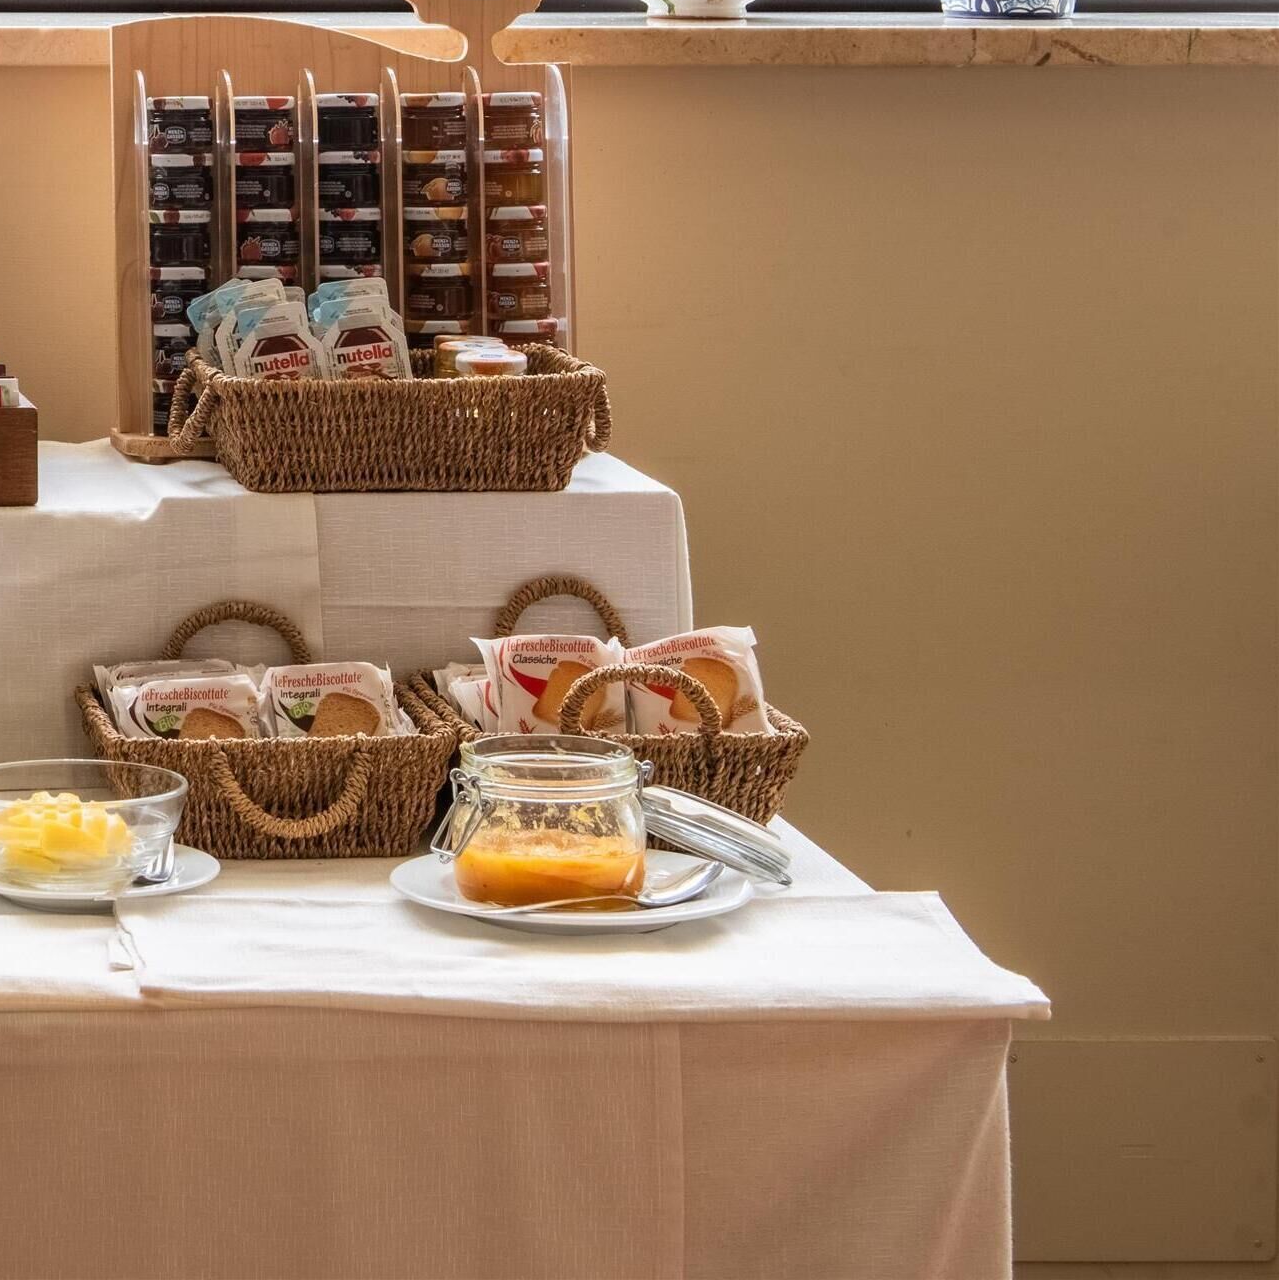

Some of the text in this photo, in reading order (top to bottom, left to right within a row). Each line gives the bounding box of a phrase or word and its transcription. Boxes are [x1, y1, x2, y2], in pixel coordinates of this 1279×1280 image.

[336, 345, 393, 364] nutella
[254, 353, 310, 373] nutella
[512, 654, 558, 664] Classiche
[280, 688, 321, 701] Integrali
[146, 702, 187, 714] Integrali
